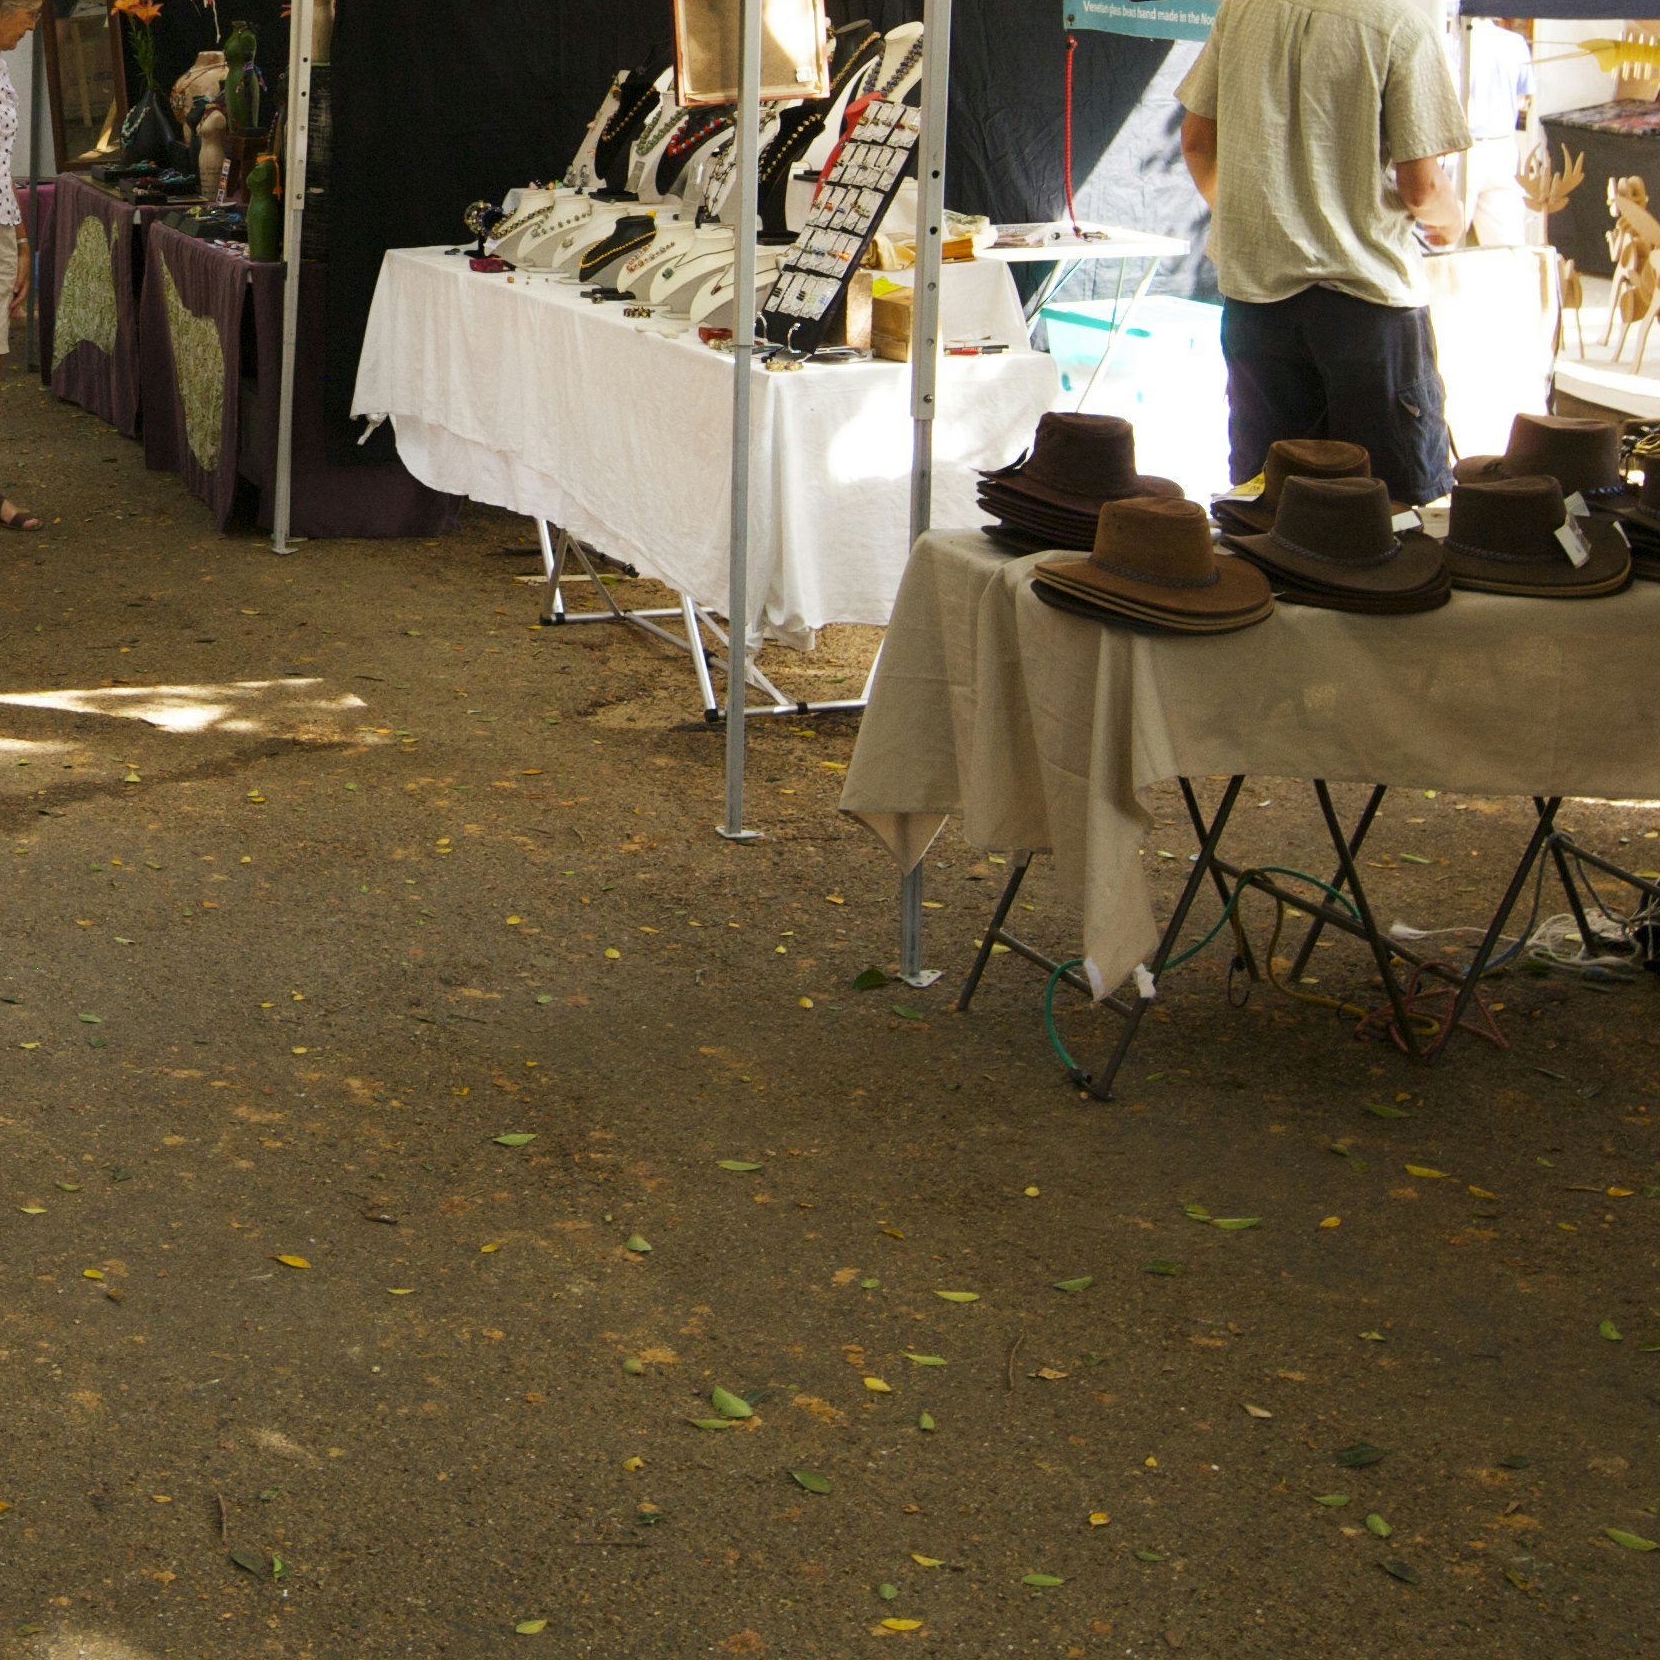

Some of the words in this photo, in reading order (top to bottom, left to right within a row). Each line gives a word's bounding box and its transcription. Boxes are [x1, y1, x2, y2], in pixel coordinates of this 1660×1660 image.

[1137, 5, 1157, 21] hand
[1157, 9, 1179, 22] made
[1179, 10, 1187, 24] in
[1187, 11, 1201, 25] the
